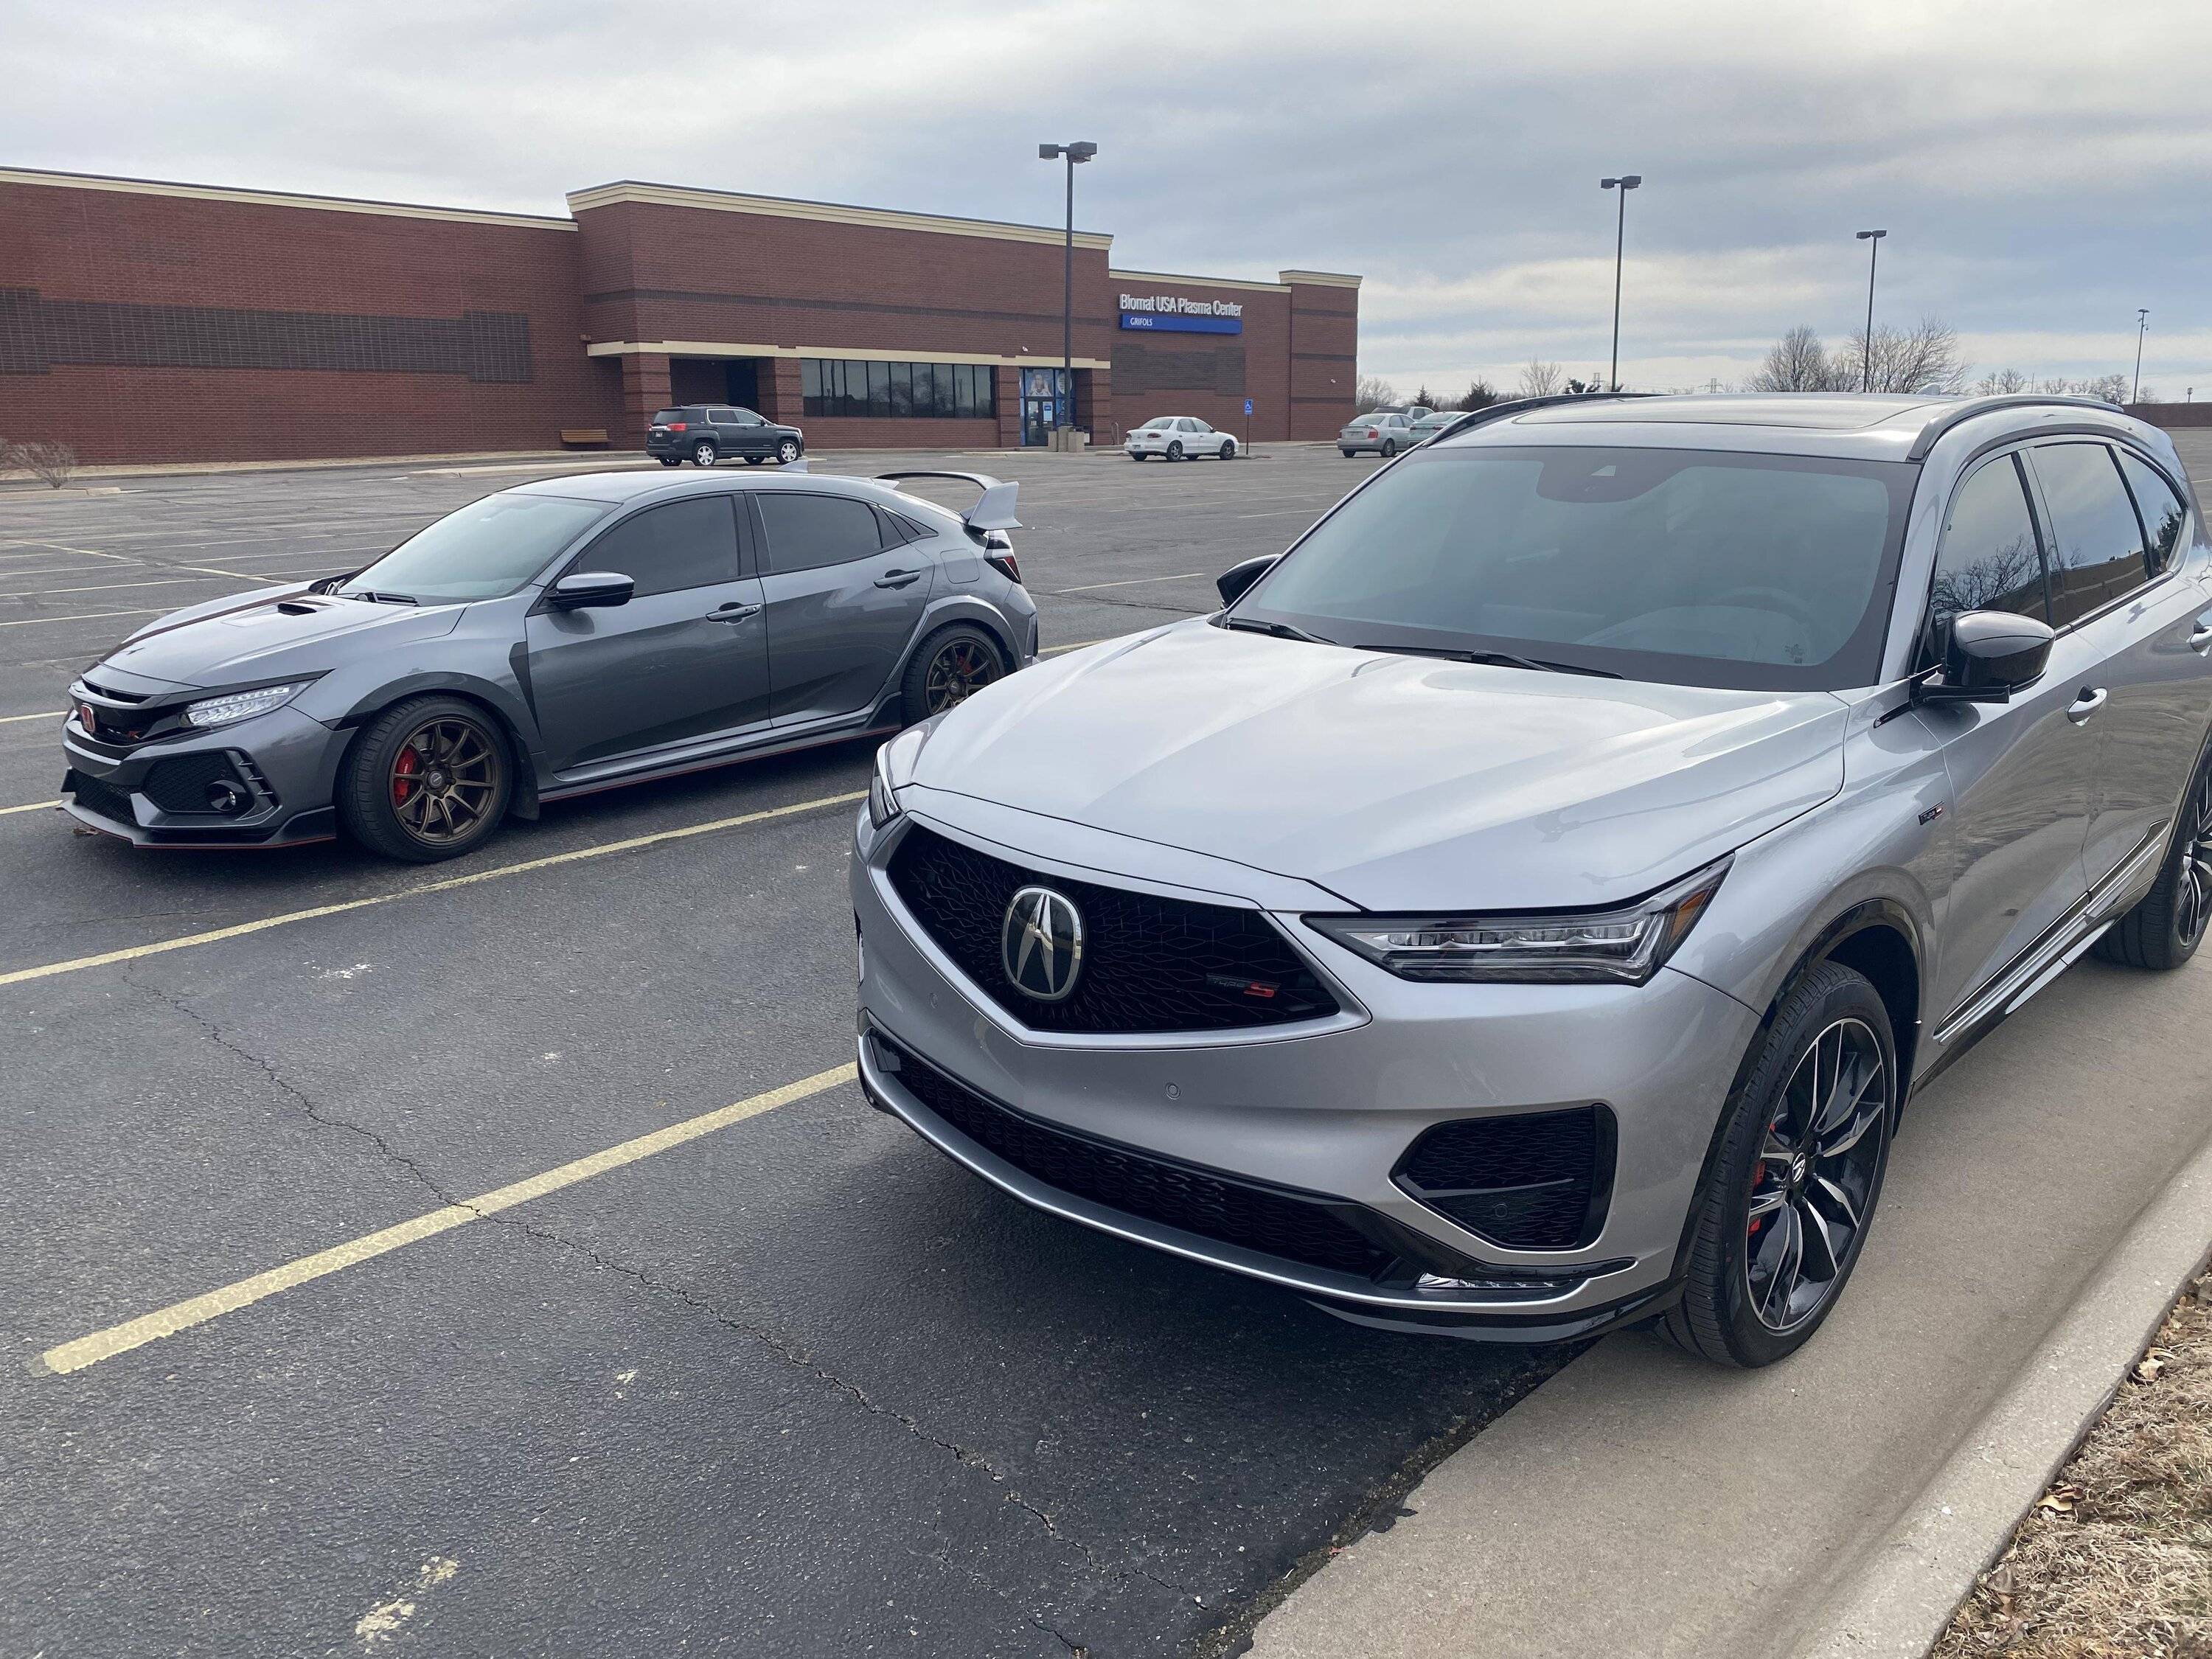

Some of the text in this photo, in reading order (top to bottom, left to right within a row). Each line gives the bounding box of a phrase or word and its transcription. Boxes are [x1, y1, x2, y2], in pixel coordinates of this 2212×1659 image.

[1120, 293, 1242, 316] Biomat USA Plasma Center
[1130, 317, 1153, 326] GRIFOLS
